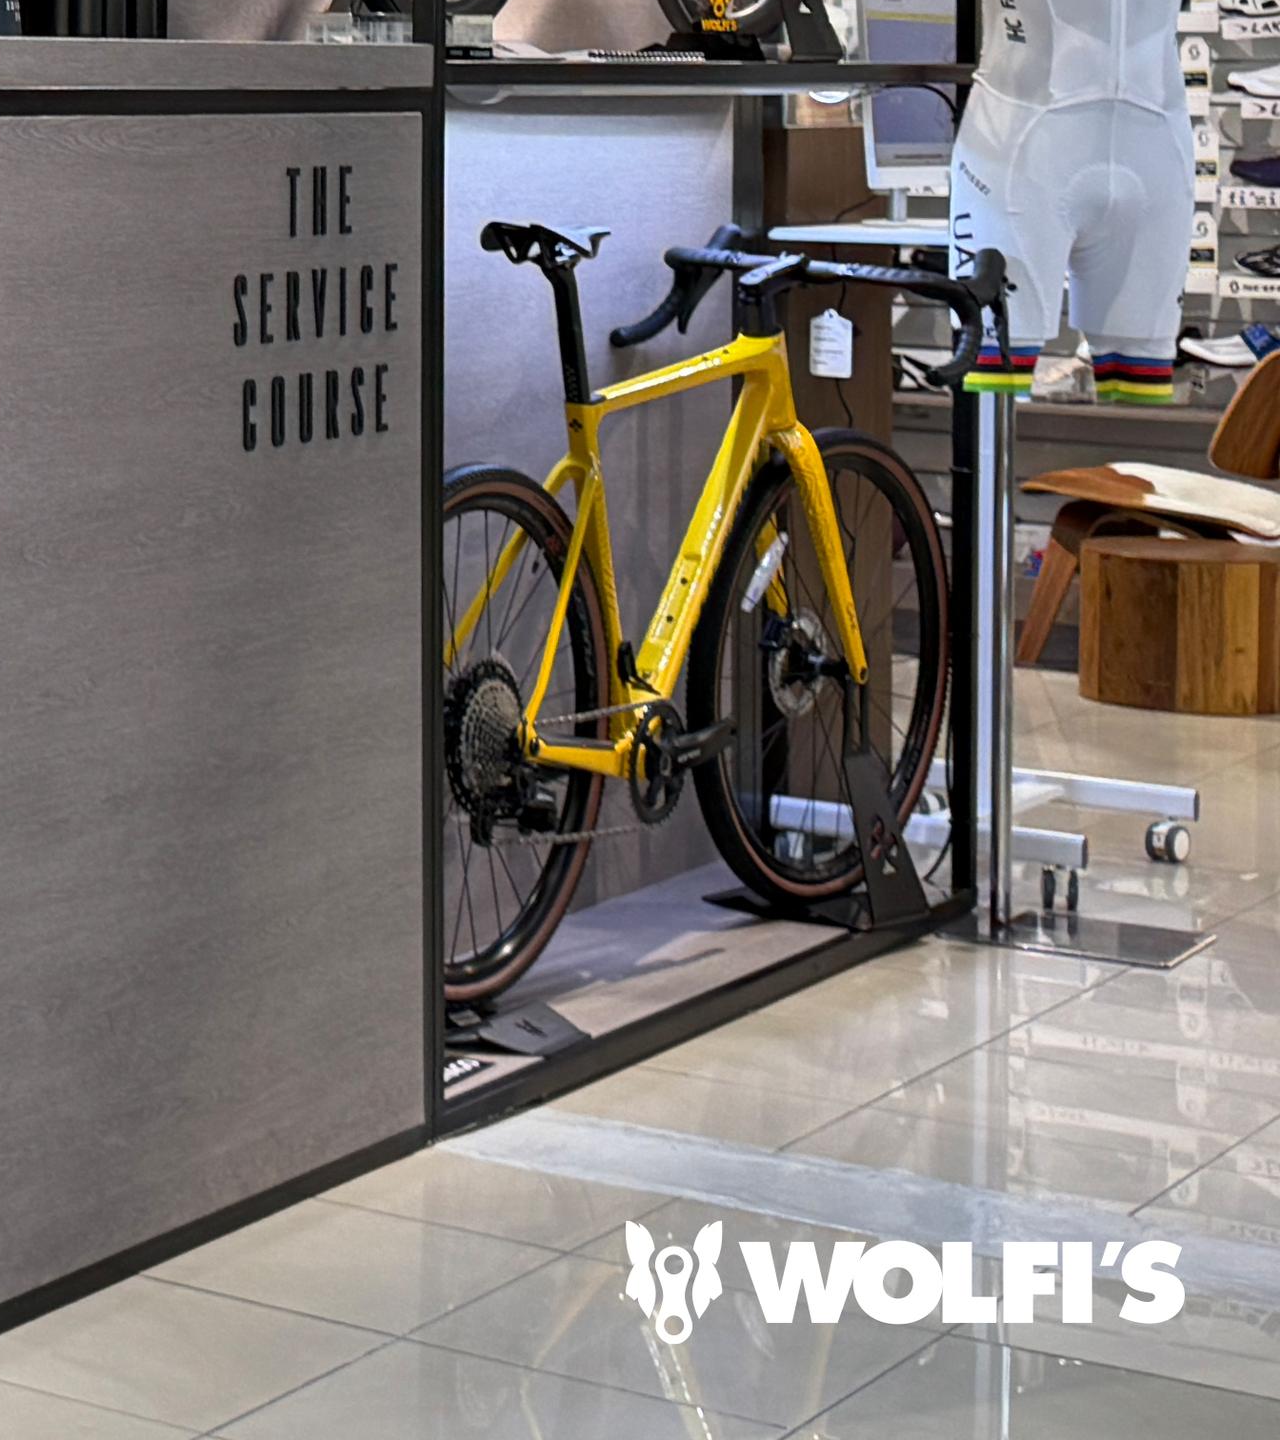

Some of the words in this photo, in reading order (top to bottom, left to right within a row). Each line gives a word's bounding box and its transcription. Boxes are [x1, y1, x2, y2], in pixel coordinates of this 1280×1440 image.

[286, 165, 353, 238] THE
[954, 212, 976, 280] UA
[233, 263, 398, 347] SERVICE
[242, 363, 389, 452] COURSE
